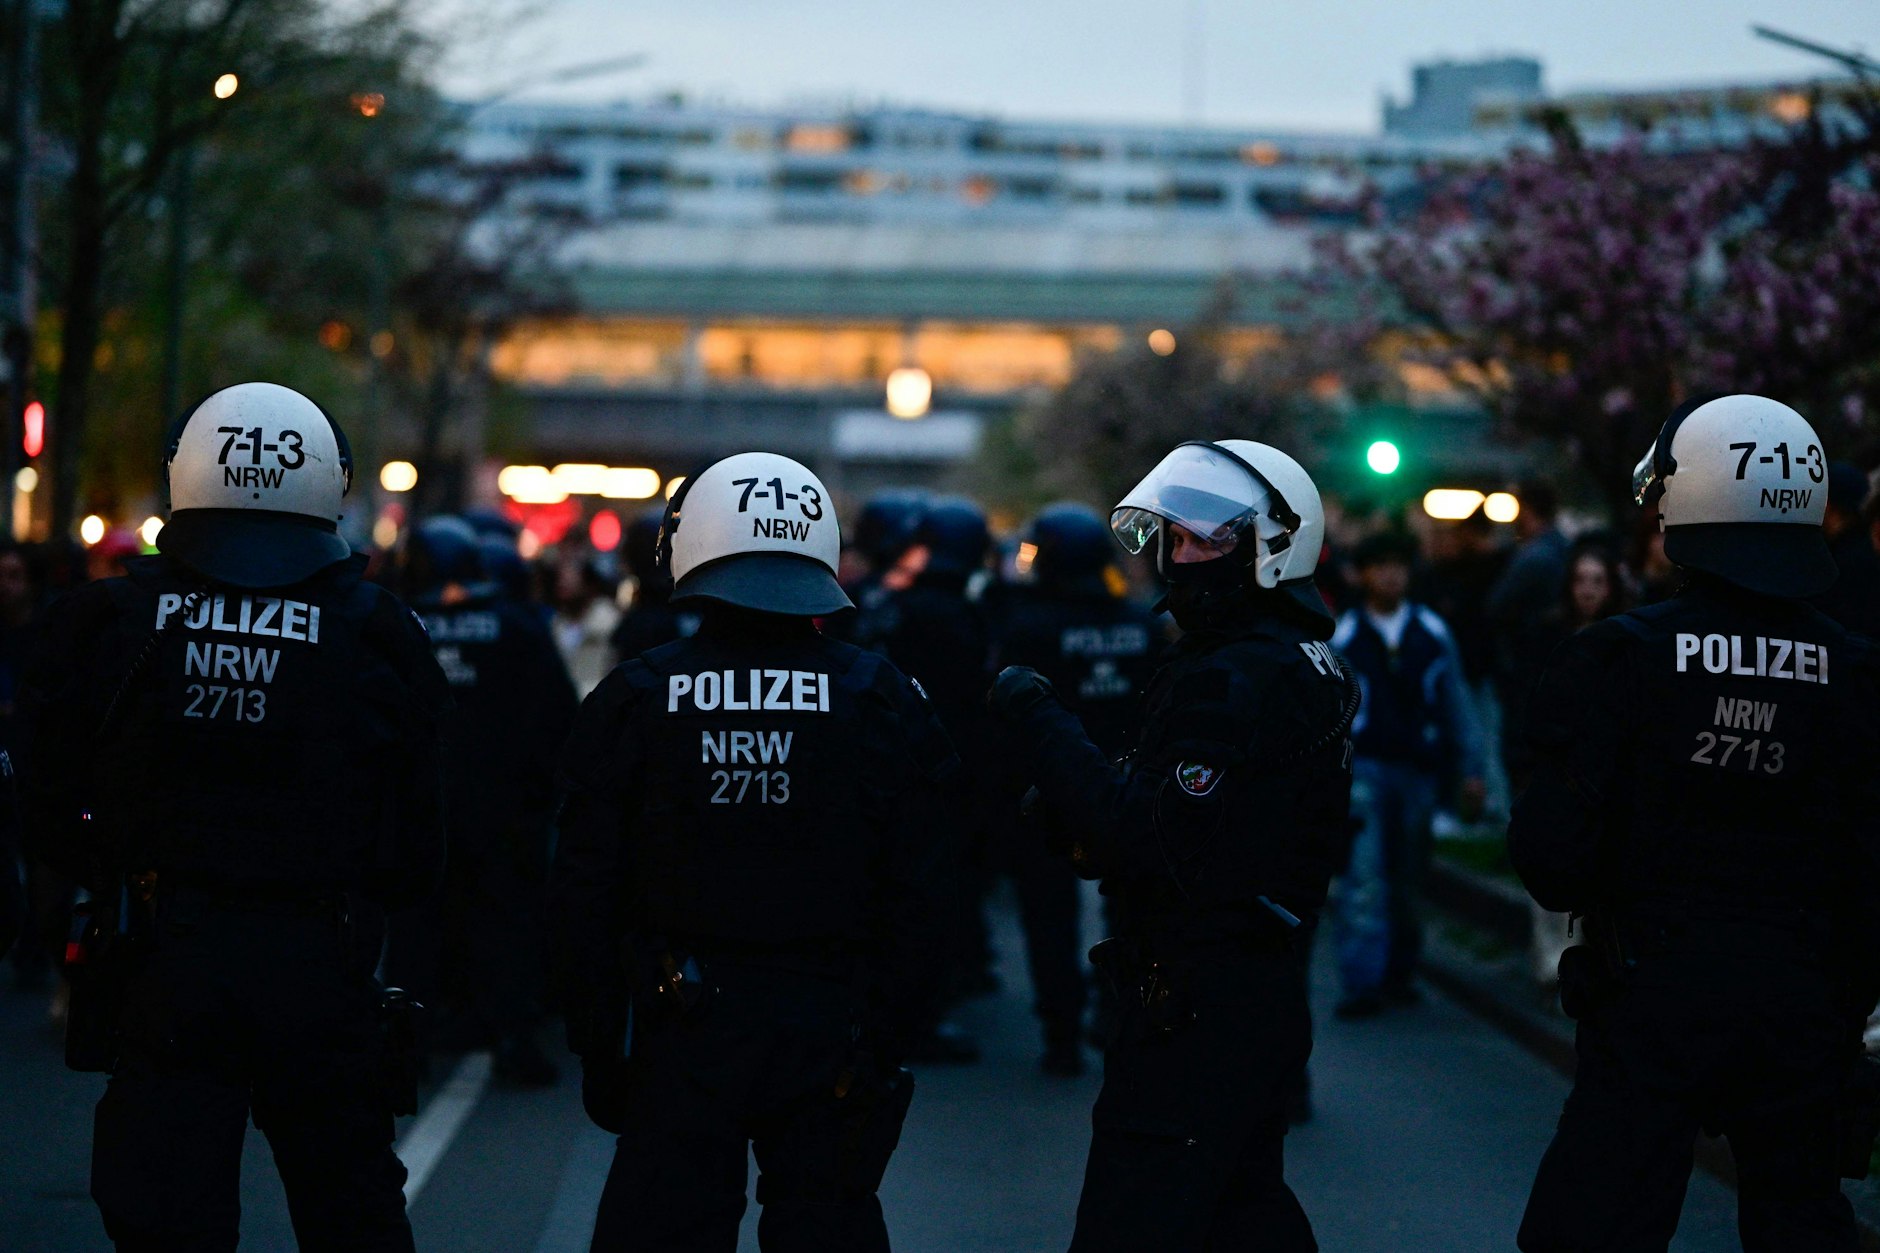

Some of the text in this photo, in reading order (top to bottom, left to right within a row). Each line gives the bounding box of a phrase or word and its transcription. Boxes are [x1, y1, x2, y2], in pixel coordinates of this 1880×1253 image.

[217, 427, 305, 470] 7-1-3
[1729, 442, 1824, 484] 7-1-3
[224, 467, 285, 489] NRW
[732, 477, 823, 521] 7-1-3
[1760, 488, 1812, 509] NRW
[753, 518, 810, 542] NRW
[155, 592, 321, 644] POLIZEI
[184, 641, 281, 684] NRW
[1675, 633, 1829, 685] POLIZEI
[183, 684, 267, 724] 2713
[667, 669, 830, 713] POLIZEI
[1714, 696, 1777, 734] NRW
[701, 731, 793, 764] NRW
[1690, 732, 1785, 775] 2713
[710, 770, 791, 804] 2713
